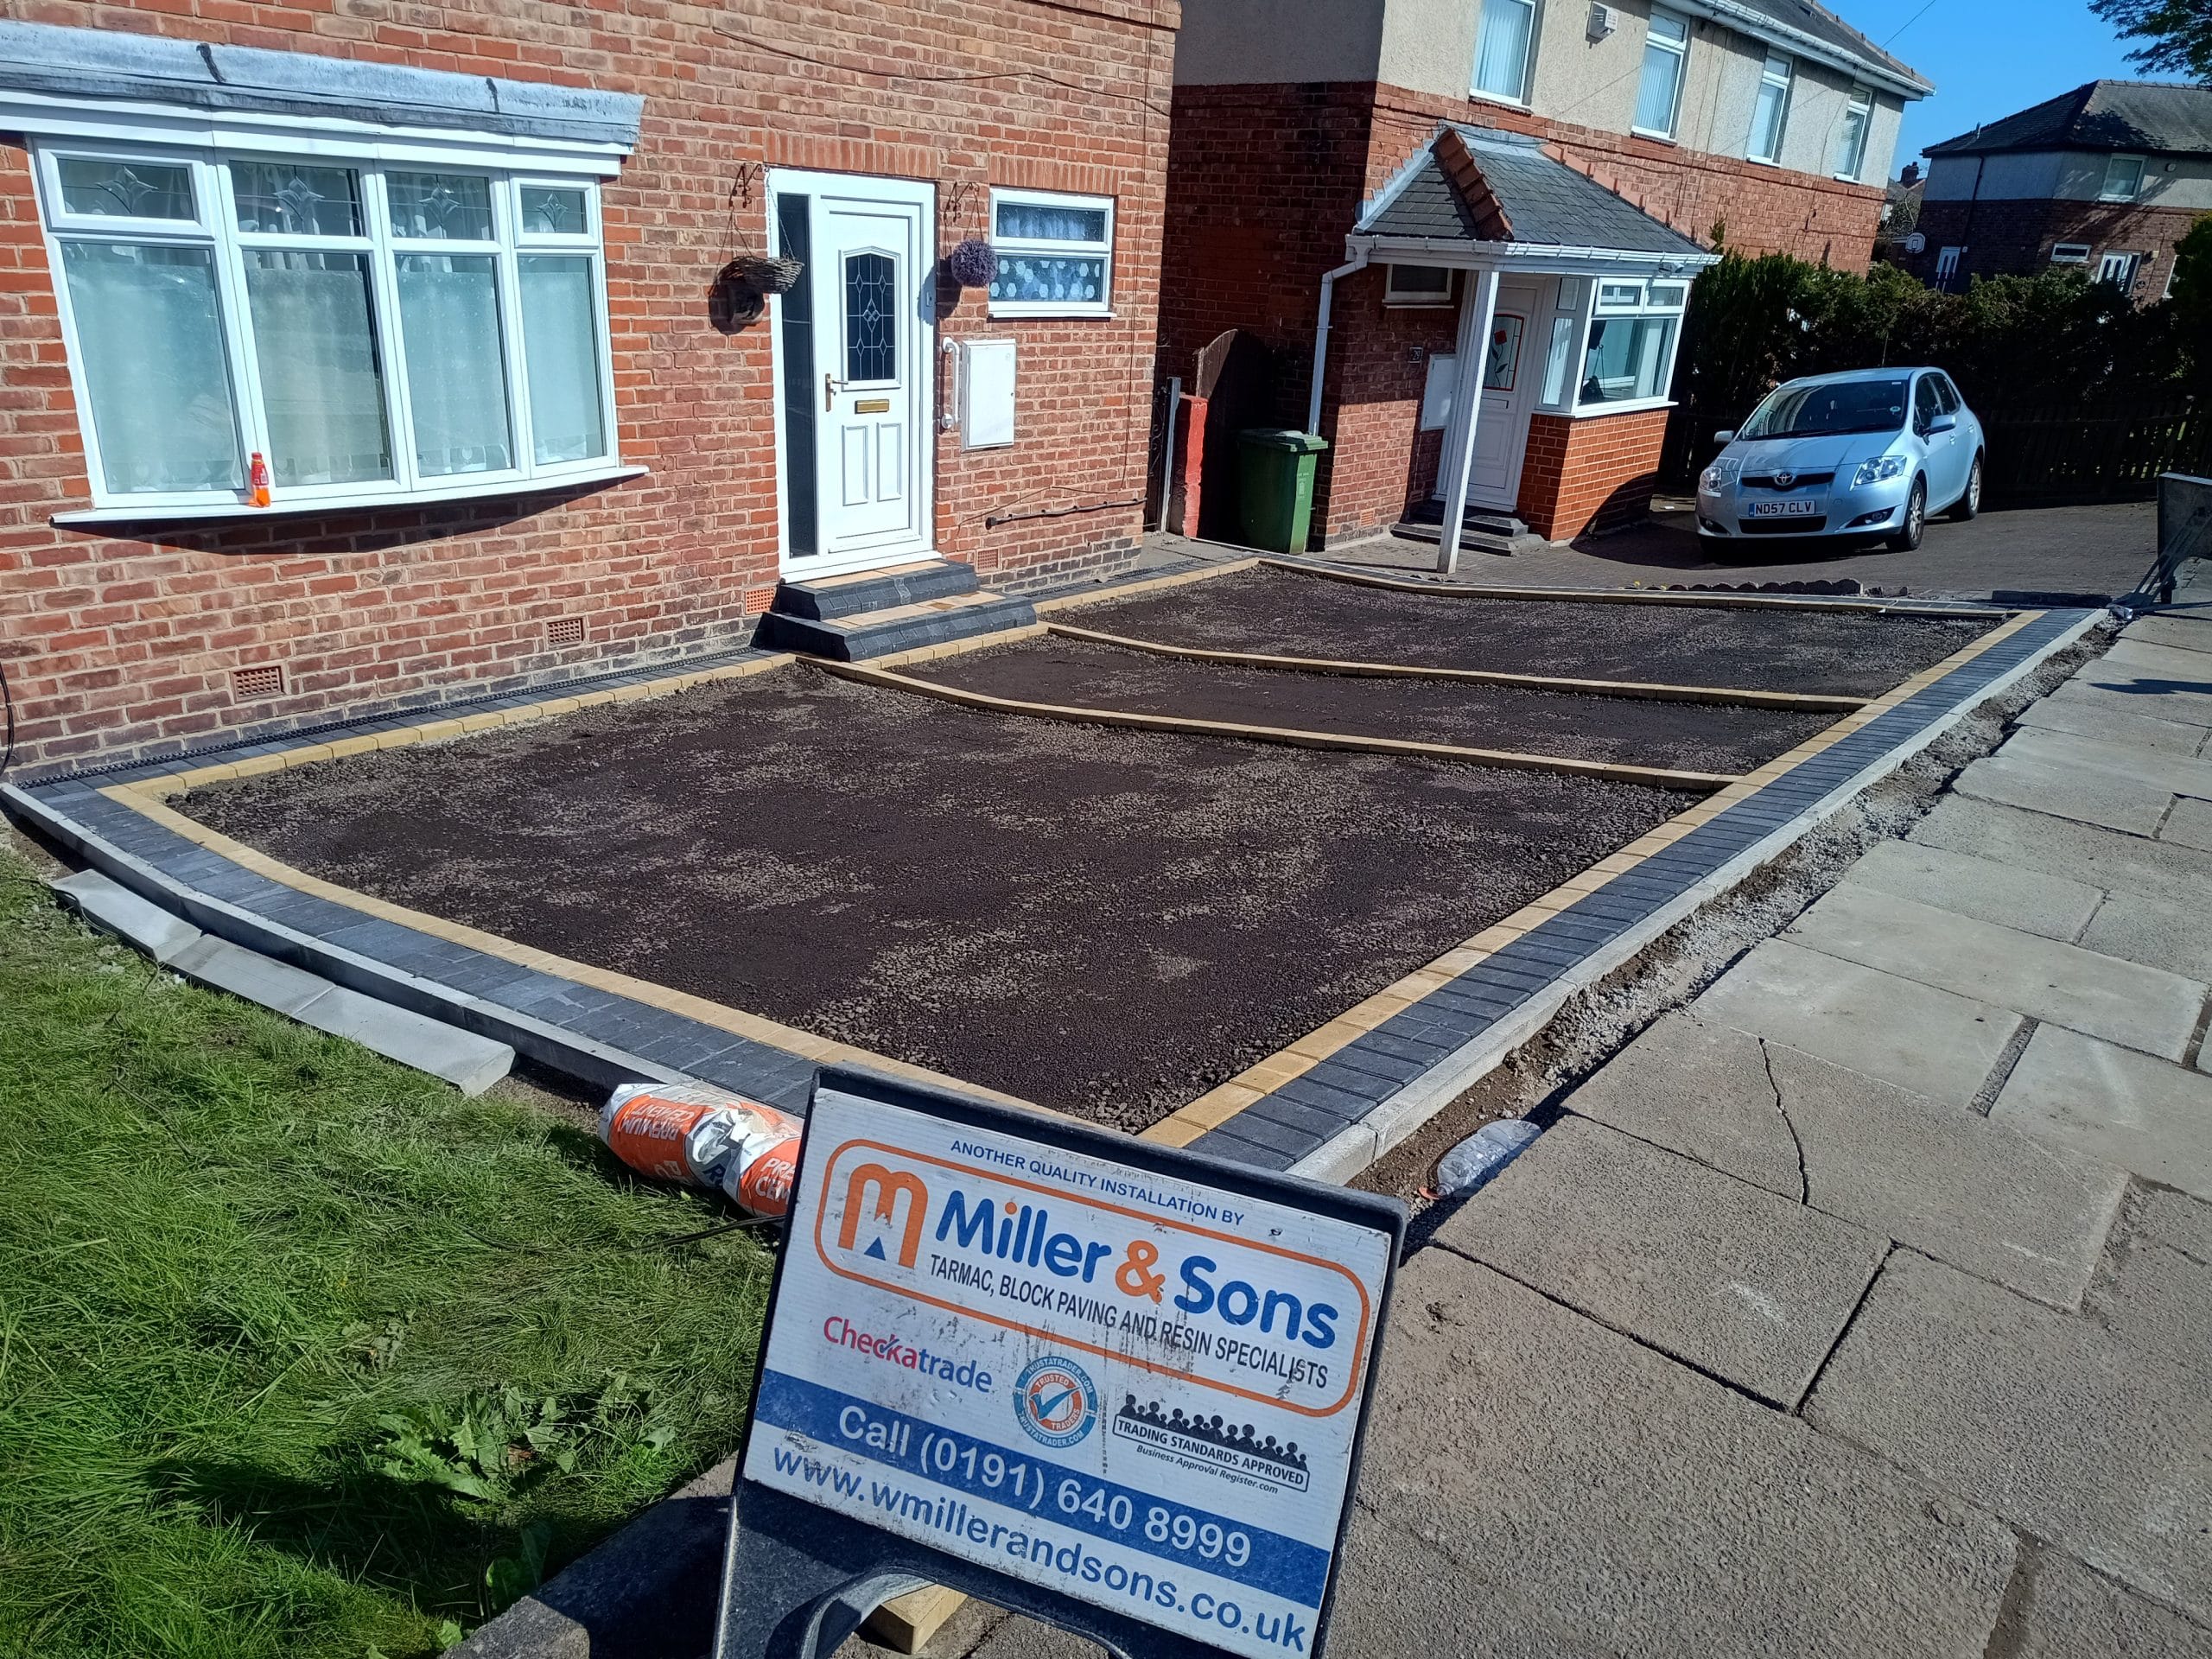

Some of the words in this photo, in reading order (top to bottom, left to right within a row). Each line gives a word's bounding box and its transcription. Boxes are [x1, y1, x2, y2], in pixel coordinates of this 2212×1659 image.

[1755, 502, 1785, 515] ND57
[1789, 501, 1812, 513] CLV
[950, 1140, 1026, 1170] ANOTHER
[1029, 1160, 1097, 1188] QUALITY
[1100, 1179, 1218, 1219] INSTALLATION
[1222, 1210, 1245, 1226] BY
[936, 1190, 1112, 1283] Miller
[1115, 1240, 1166, 1304] &
[1173, 1255, 1338, 1350] Sons
[823, 1316, 993, 1393] Checkatrade
[931, 1254, 995, 1297] TARMAC,
[999, 1274, 1055, 1311] BLOCK
[1057, 1291, 1117, 1328] PAVING
[1119, 1310, 1157, 1339] AND
[1160, 1320, 1212, 1357] RESIN
[1215, 1337, 1329, 1389] SPECIALISTS
[1025, 1357, 1094, 1395] TRUSTATRADER.COM
[1035, 1374, 1070, 1388] TRUSTED
[1018, 1410, 1084, 1447] TRUSTATRADER.COM
[1051, 1408, 1080, 1431] TRADERS
[1118, 1419, 1167, 1445] TRADING
[1170, 1435, 1239, 1466] STANDARDS
[1241, 1457, 1305, 1485] APPROVED
[839, 1405, 911, 1457] Call
[920, 1432, 1045, 1510] (0191)
[1057, 1478, 1134, 1530] 640
[1144, 1507, 1251, 1567] 8999
[1136, 1444, 1174, 1464] Business
[1175, 1456, 1218, 1478] Approval
[1219, 1470, 1279, 1495] Register.com
[773, 1446, 1306, 1652] www.wmillerandsons.co.uk
